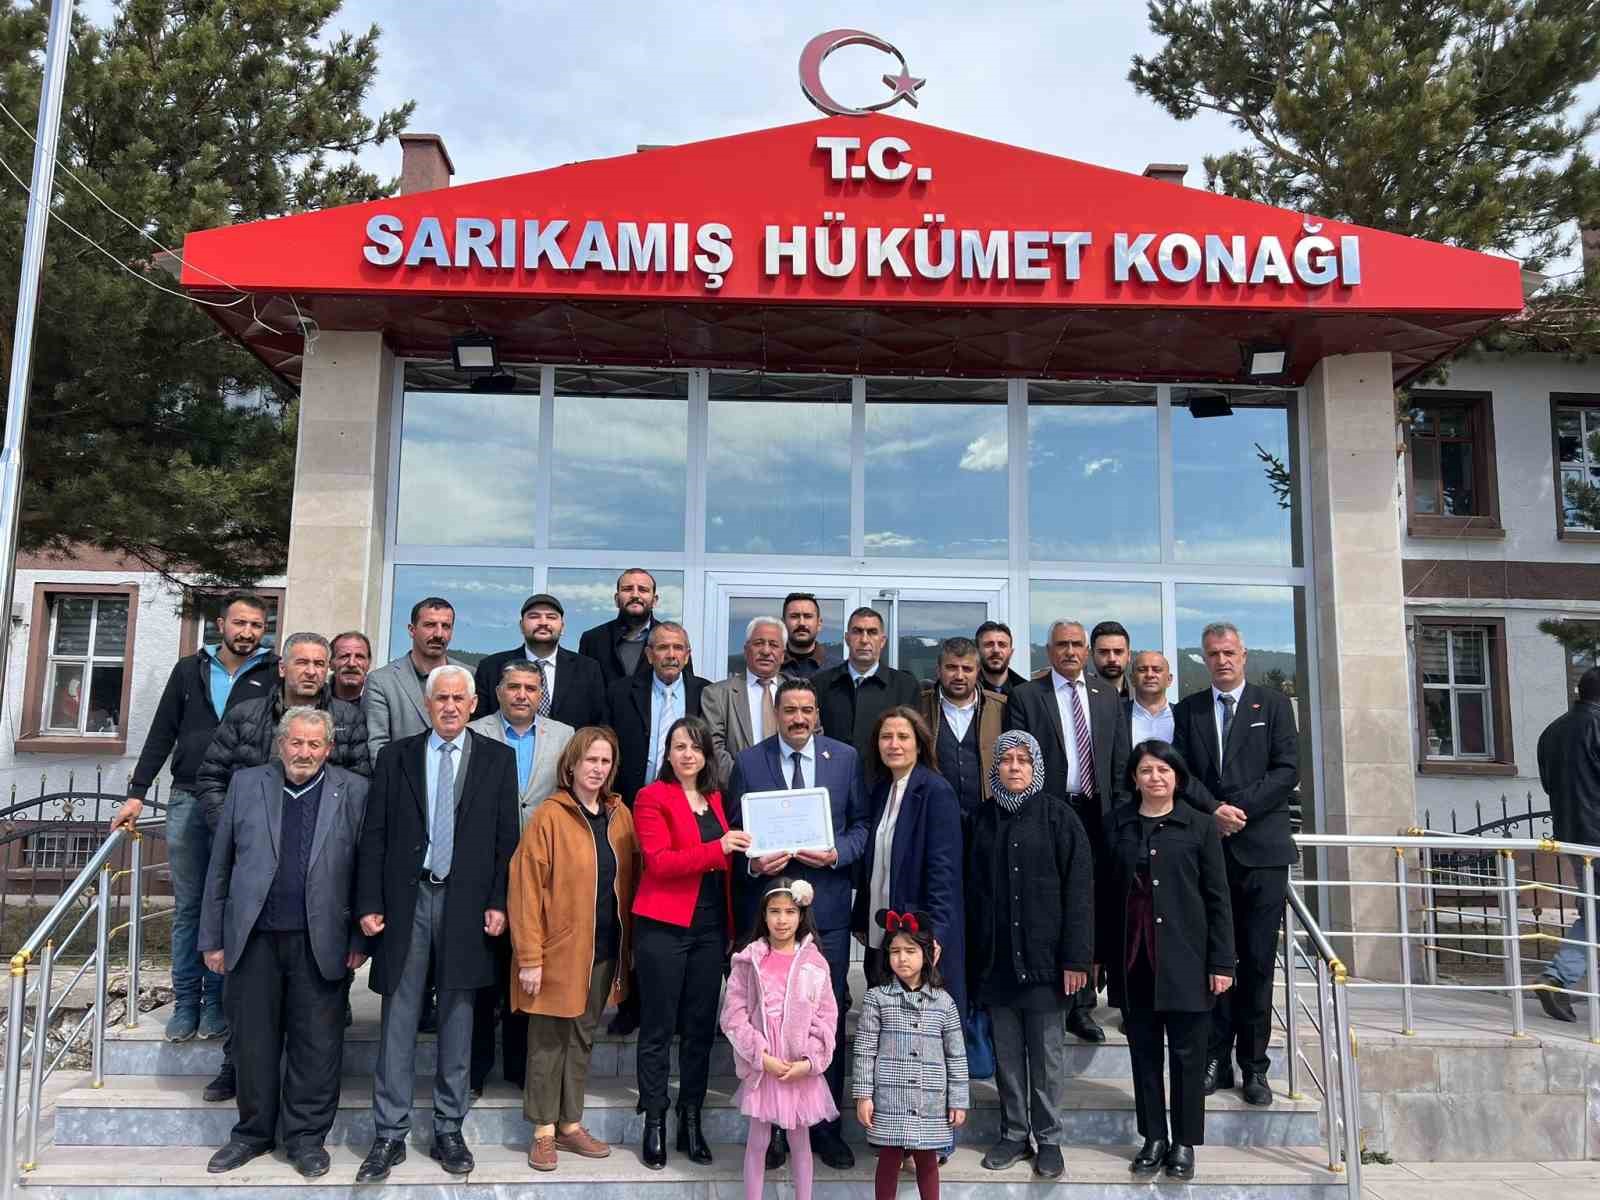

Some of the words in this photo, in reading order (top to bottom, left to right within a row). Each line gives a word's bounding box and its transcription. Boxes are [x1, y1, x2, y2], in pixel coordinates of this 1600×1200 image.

[816, 136, 932, 182] T.C.
[362, 214, 734, 289] SARIKAMIŞ
[764, 211, 1093, 281] HÜKÜMET
[1112, 222, 1361, 286] KONAĞI
